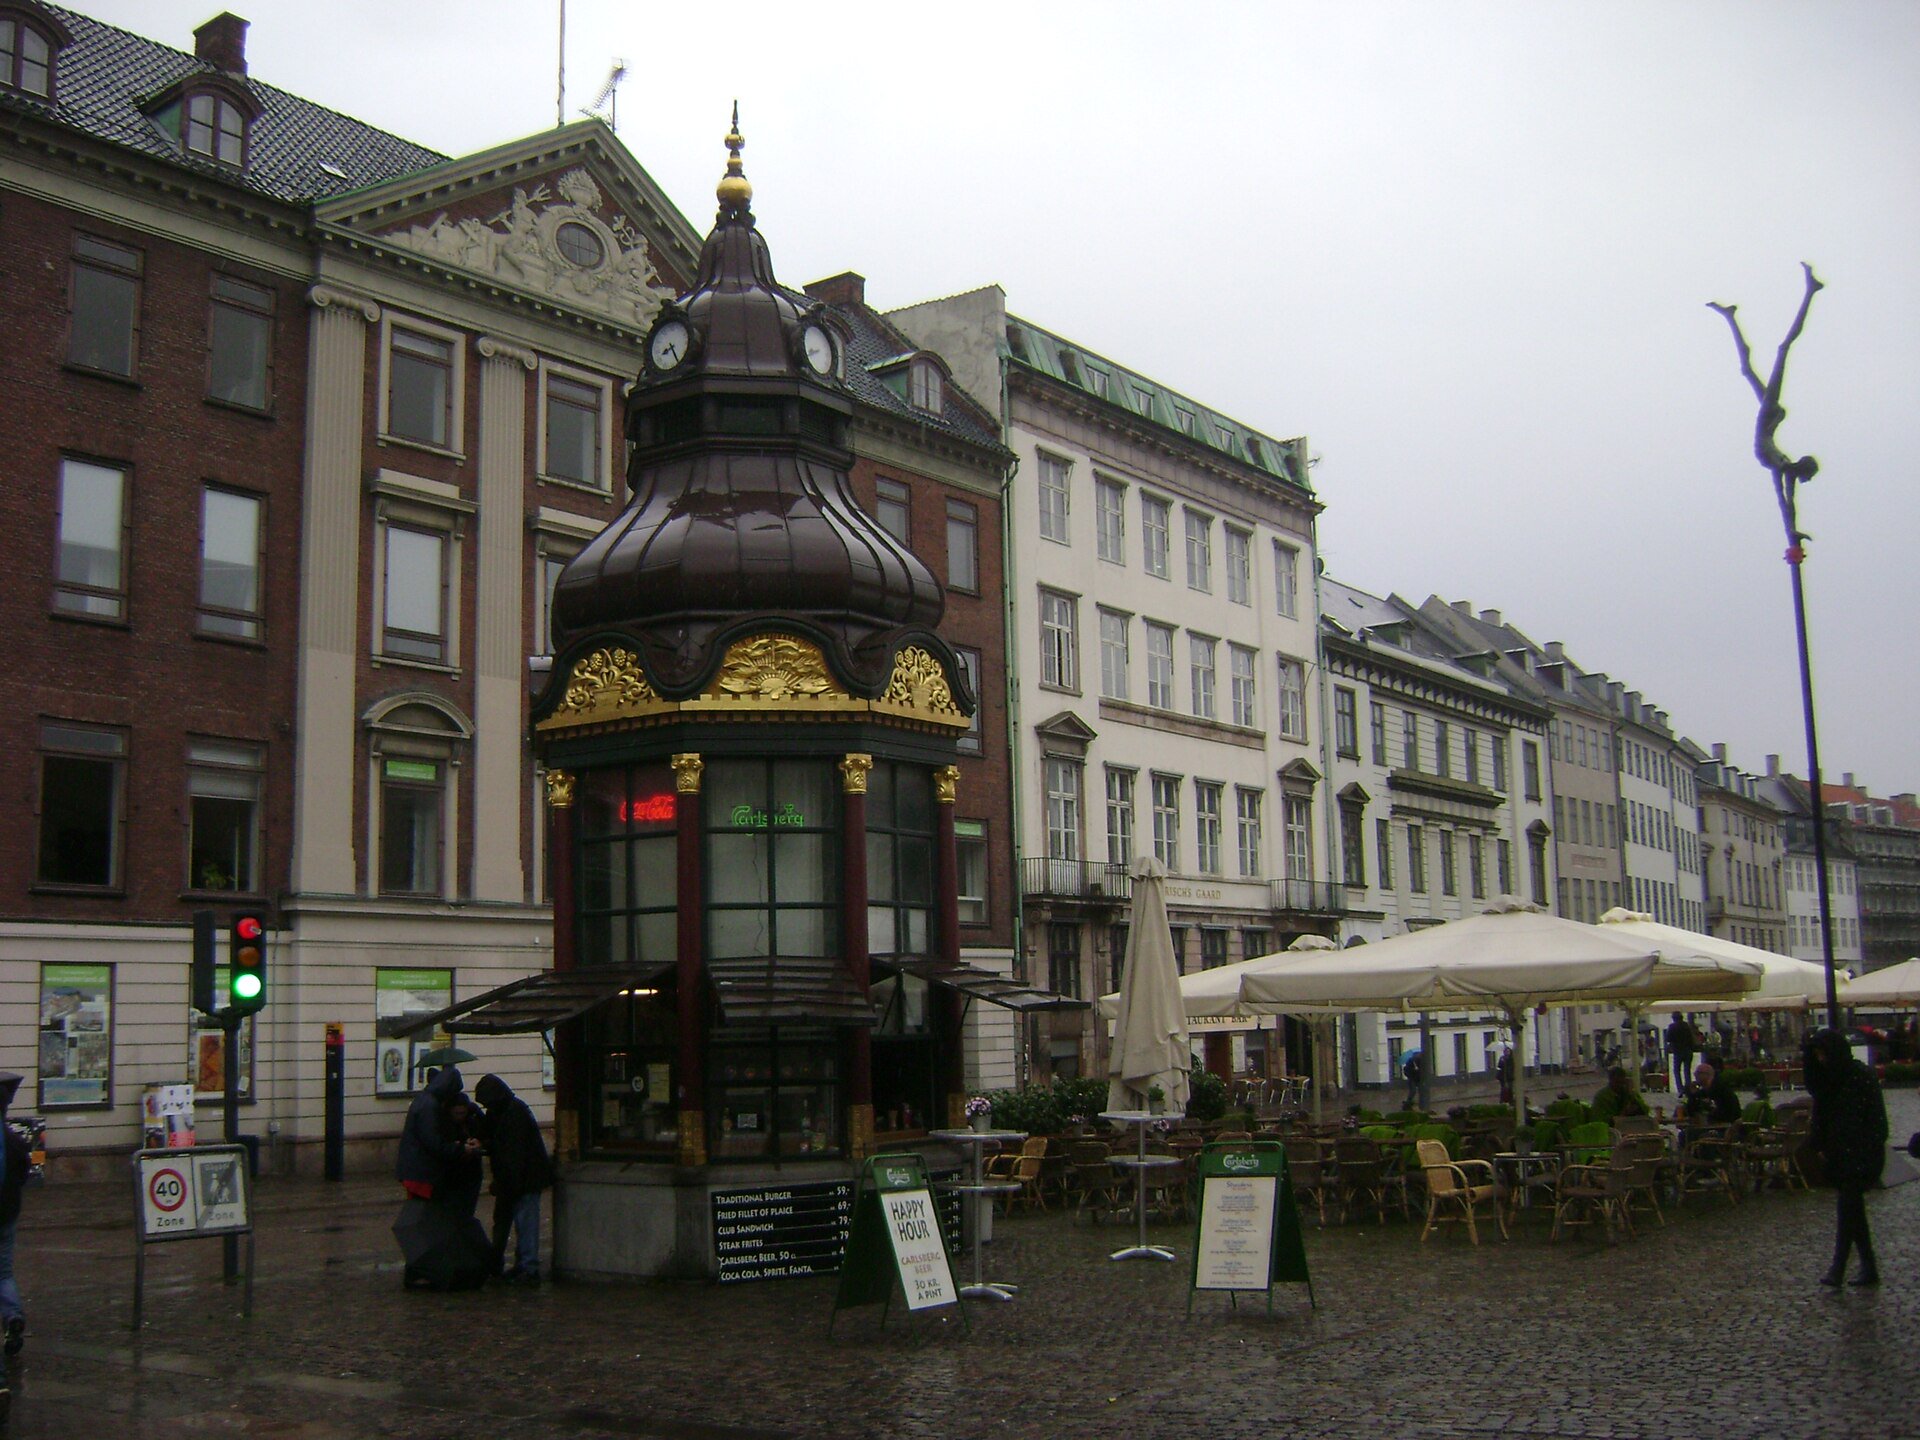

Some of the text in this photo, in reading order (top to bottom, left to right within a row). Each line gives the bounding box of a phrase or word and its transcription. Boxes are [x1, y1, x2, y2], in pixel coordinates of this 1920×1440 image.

[1196, 888, 1221, 900] GAARD
[1187, 1016, 1226, 1026] TAURANT
[1223, 1154, 1259, 1170] Carlsberg
[156, 1181, 179, 1197] 40
[716, 1194, 763, 1204] TRADITIONAL
[764, 1191, 792, 1201] BURGER
[717, 1210, 736, 1220] FRIED
[738, 1208, 759, 1219] FILLET
[760, 1208, 769, 1217] OF
[770, 1206, 793, 1216] PLAICE
[890, 1199, 925, 1221] HAPPY
[157, 1216, 185, 1227] Zone
[718, 1226, 736, 1235] CLUB
[737, 1222, 774, 1234] SANDWICH
[897, 1220, 931, 1242] HOUR
[719, 1241, 740, 1251] STEAK
[742, 1239, 764, 1248] FRITES
[720, 1255, 758, 1265] CARLSBERG
[780, 1251, 790, 1260] 50
[901, 1251, 941, 1266] CARLSBERG
[721, 1271, 740, 1280] COCA
[915, 1280, 925, 1290] 30
[918, 1288, 942, 1300] A PINT
